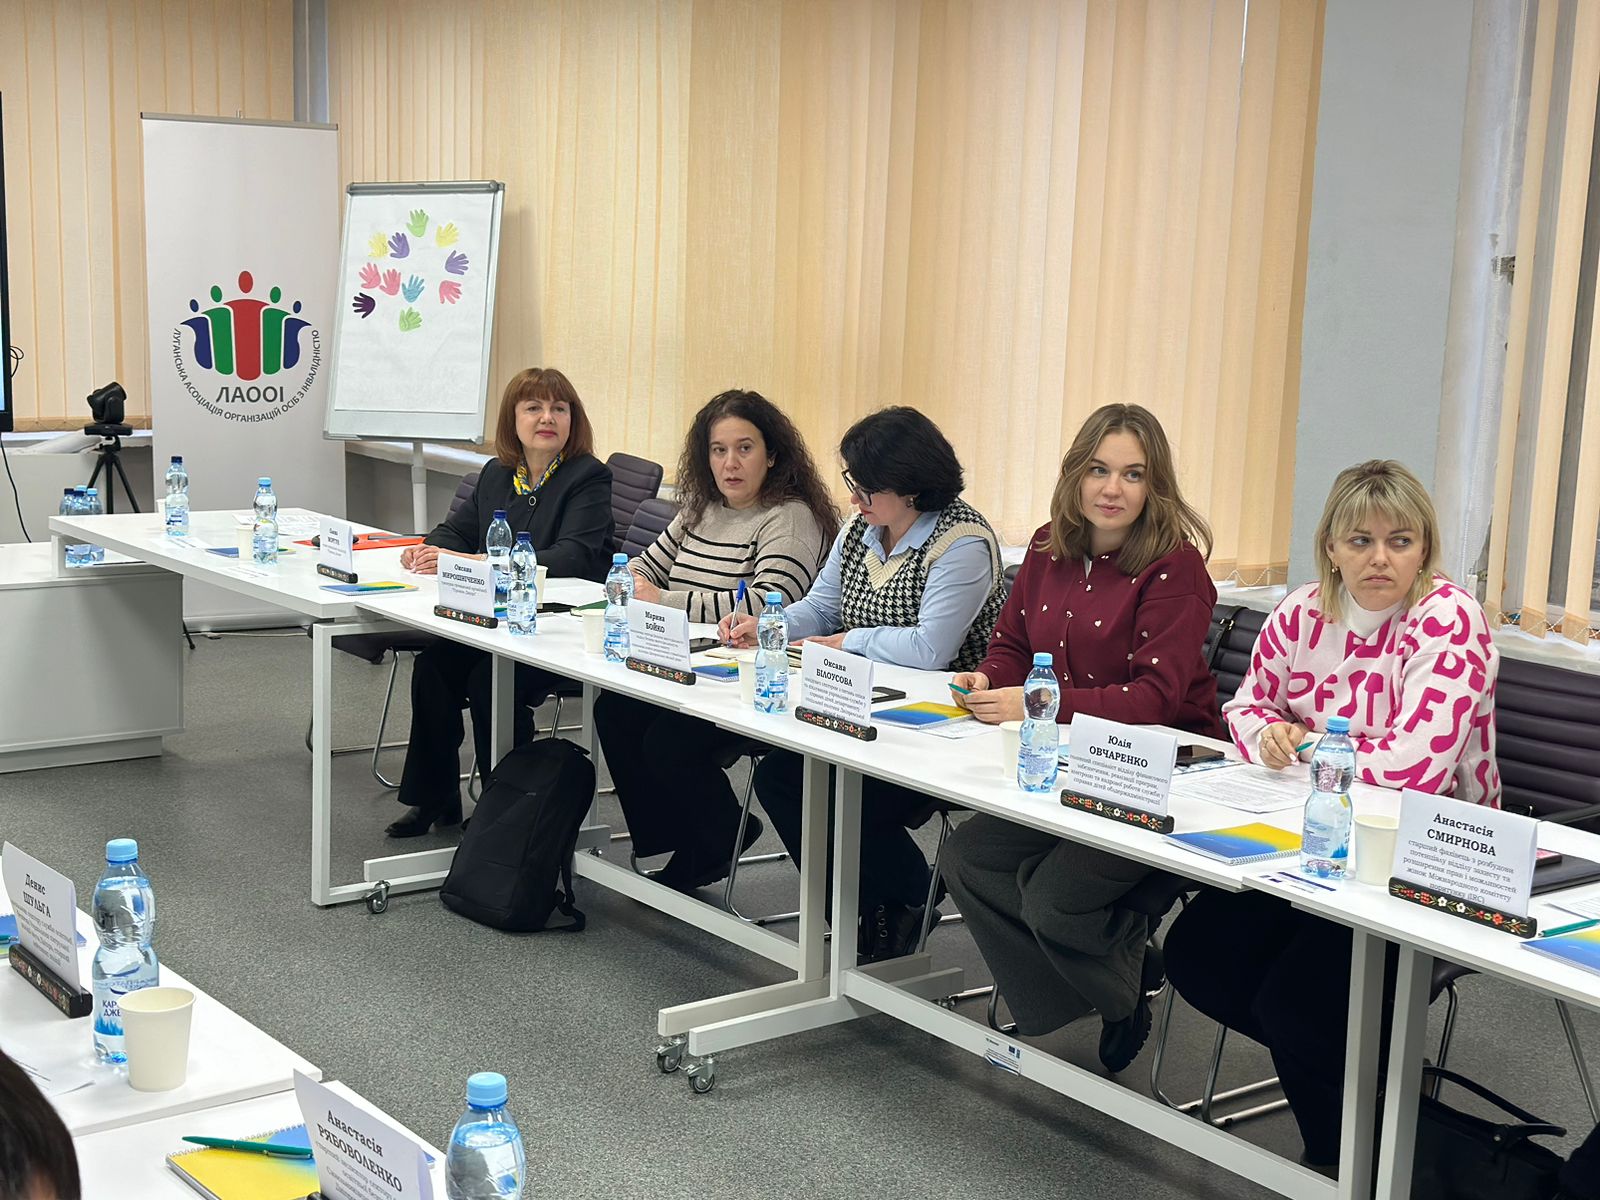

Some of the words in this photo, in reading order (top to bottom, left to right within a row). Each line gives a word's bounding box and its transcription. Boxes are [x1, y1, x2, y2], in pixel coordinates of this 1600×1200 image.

[173, 328, 188, 382] ЛУГАНСЬКА
[184, 381, 223, 417] АСОЦІАЦІЯ
[224, 407, 281, 422] ОРГАНІЗАЦІЙ
[281, 397, 299, 412] ОСІБ
[302, 329, 321, 392] ІНВАЛІДНІСТЮ
[216, 386, 284, 403] ЛАООІ
[824, 658, 846, 672] Оксана
[816, 668, 853, 687] БІЛОУСОВА
[1108, 735, 1132, 749] Юлія
[1089, 745, 1149, 768] ОВЧАРЕНКО
[1433, 812, 1494, 837] Анастасія
[1427, 827, 1496, 856] СМИРНОВА
[25, 873, 46, 895] Денис
[23, 891, 51, 918] ШУЛЬГА
[328, 1109, 383, 1157] Анастасія
[317, 1123, 403, 1192] РЯБОВОЛЕНКО
